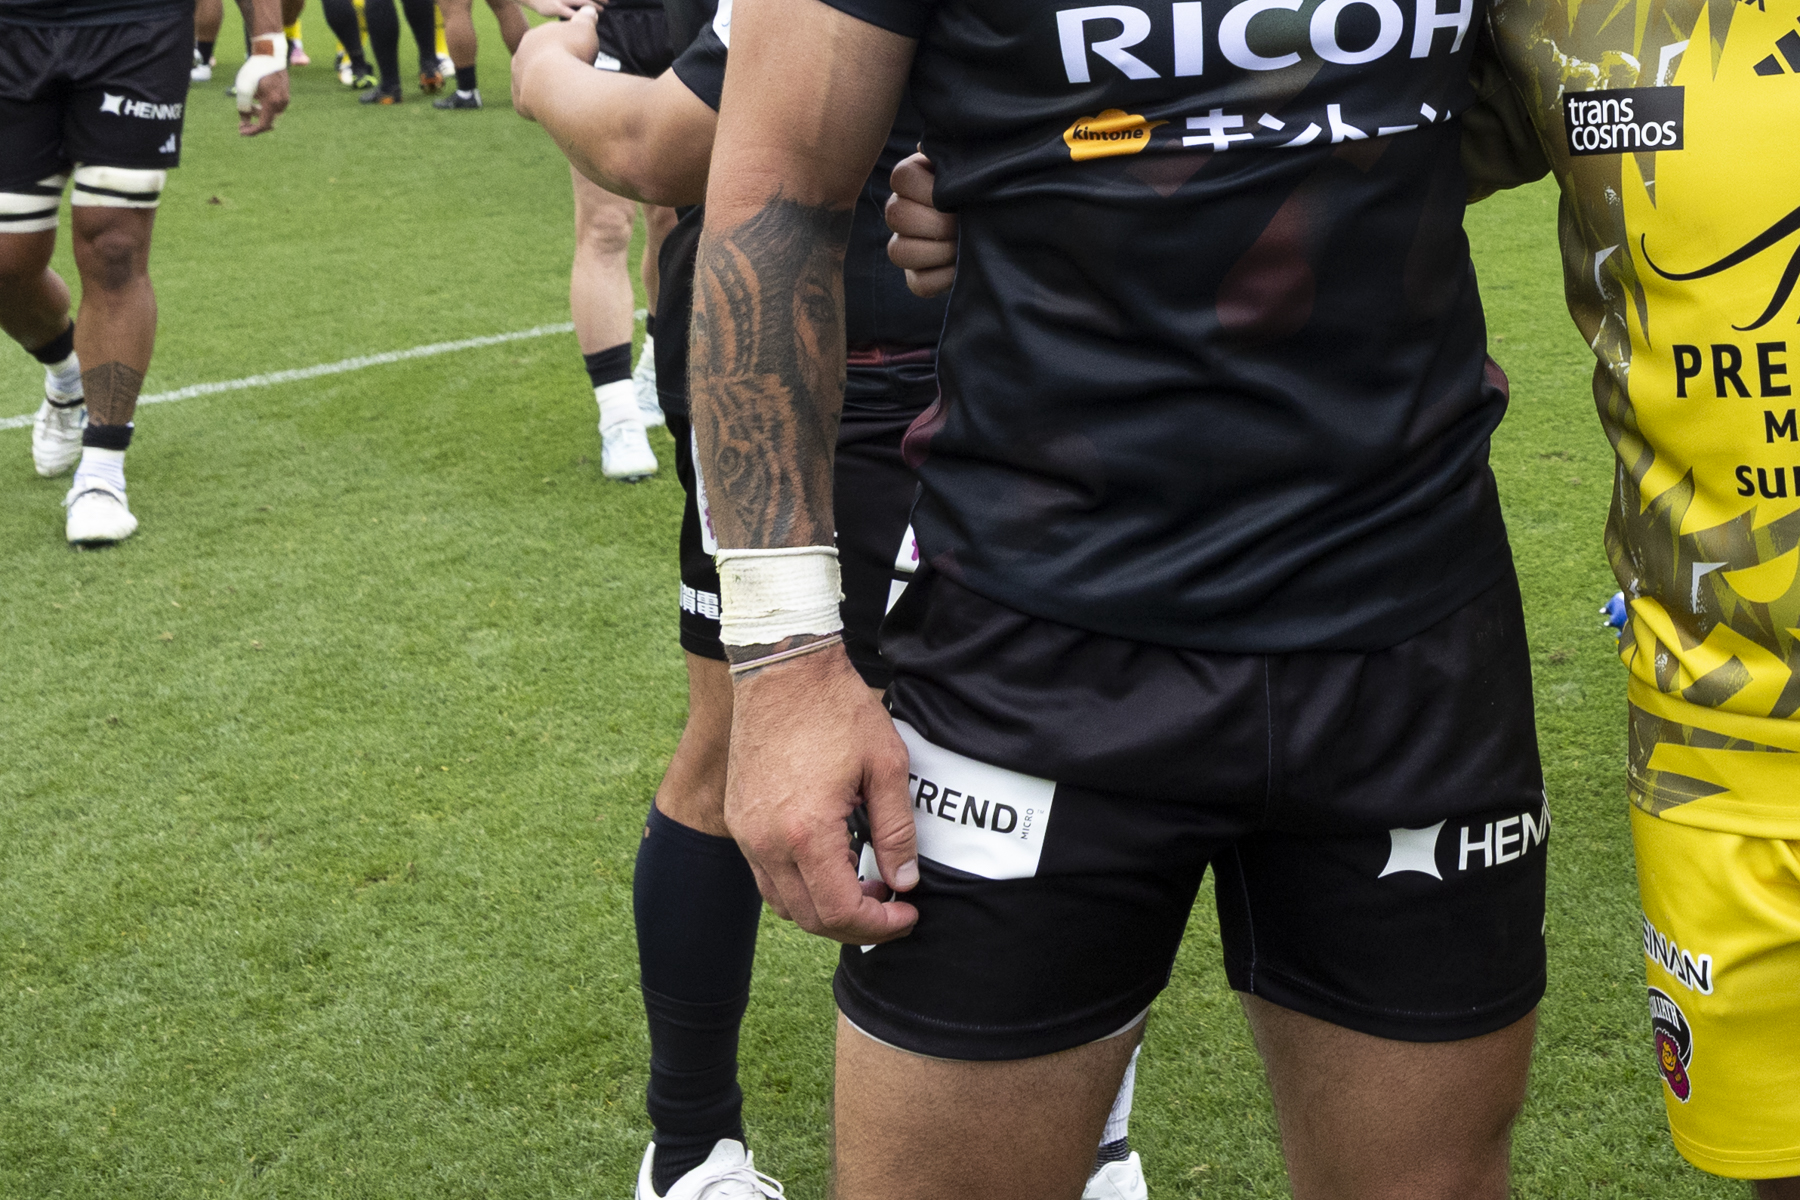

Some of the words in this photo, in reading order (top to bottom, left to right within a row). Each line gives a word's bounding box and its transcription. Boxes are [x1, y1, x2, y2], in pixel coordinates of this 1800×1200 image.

[1567, 97, 1635, 127] trans
[1072, 123, 1145, 142] kintone
[1571, 120, 1677, 151] cosmos
[1020, 807, 1035, 841] MICRO
